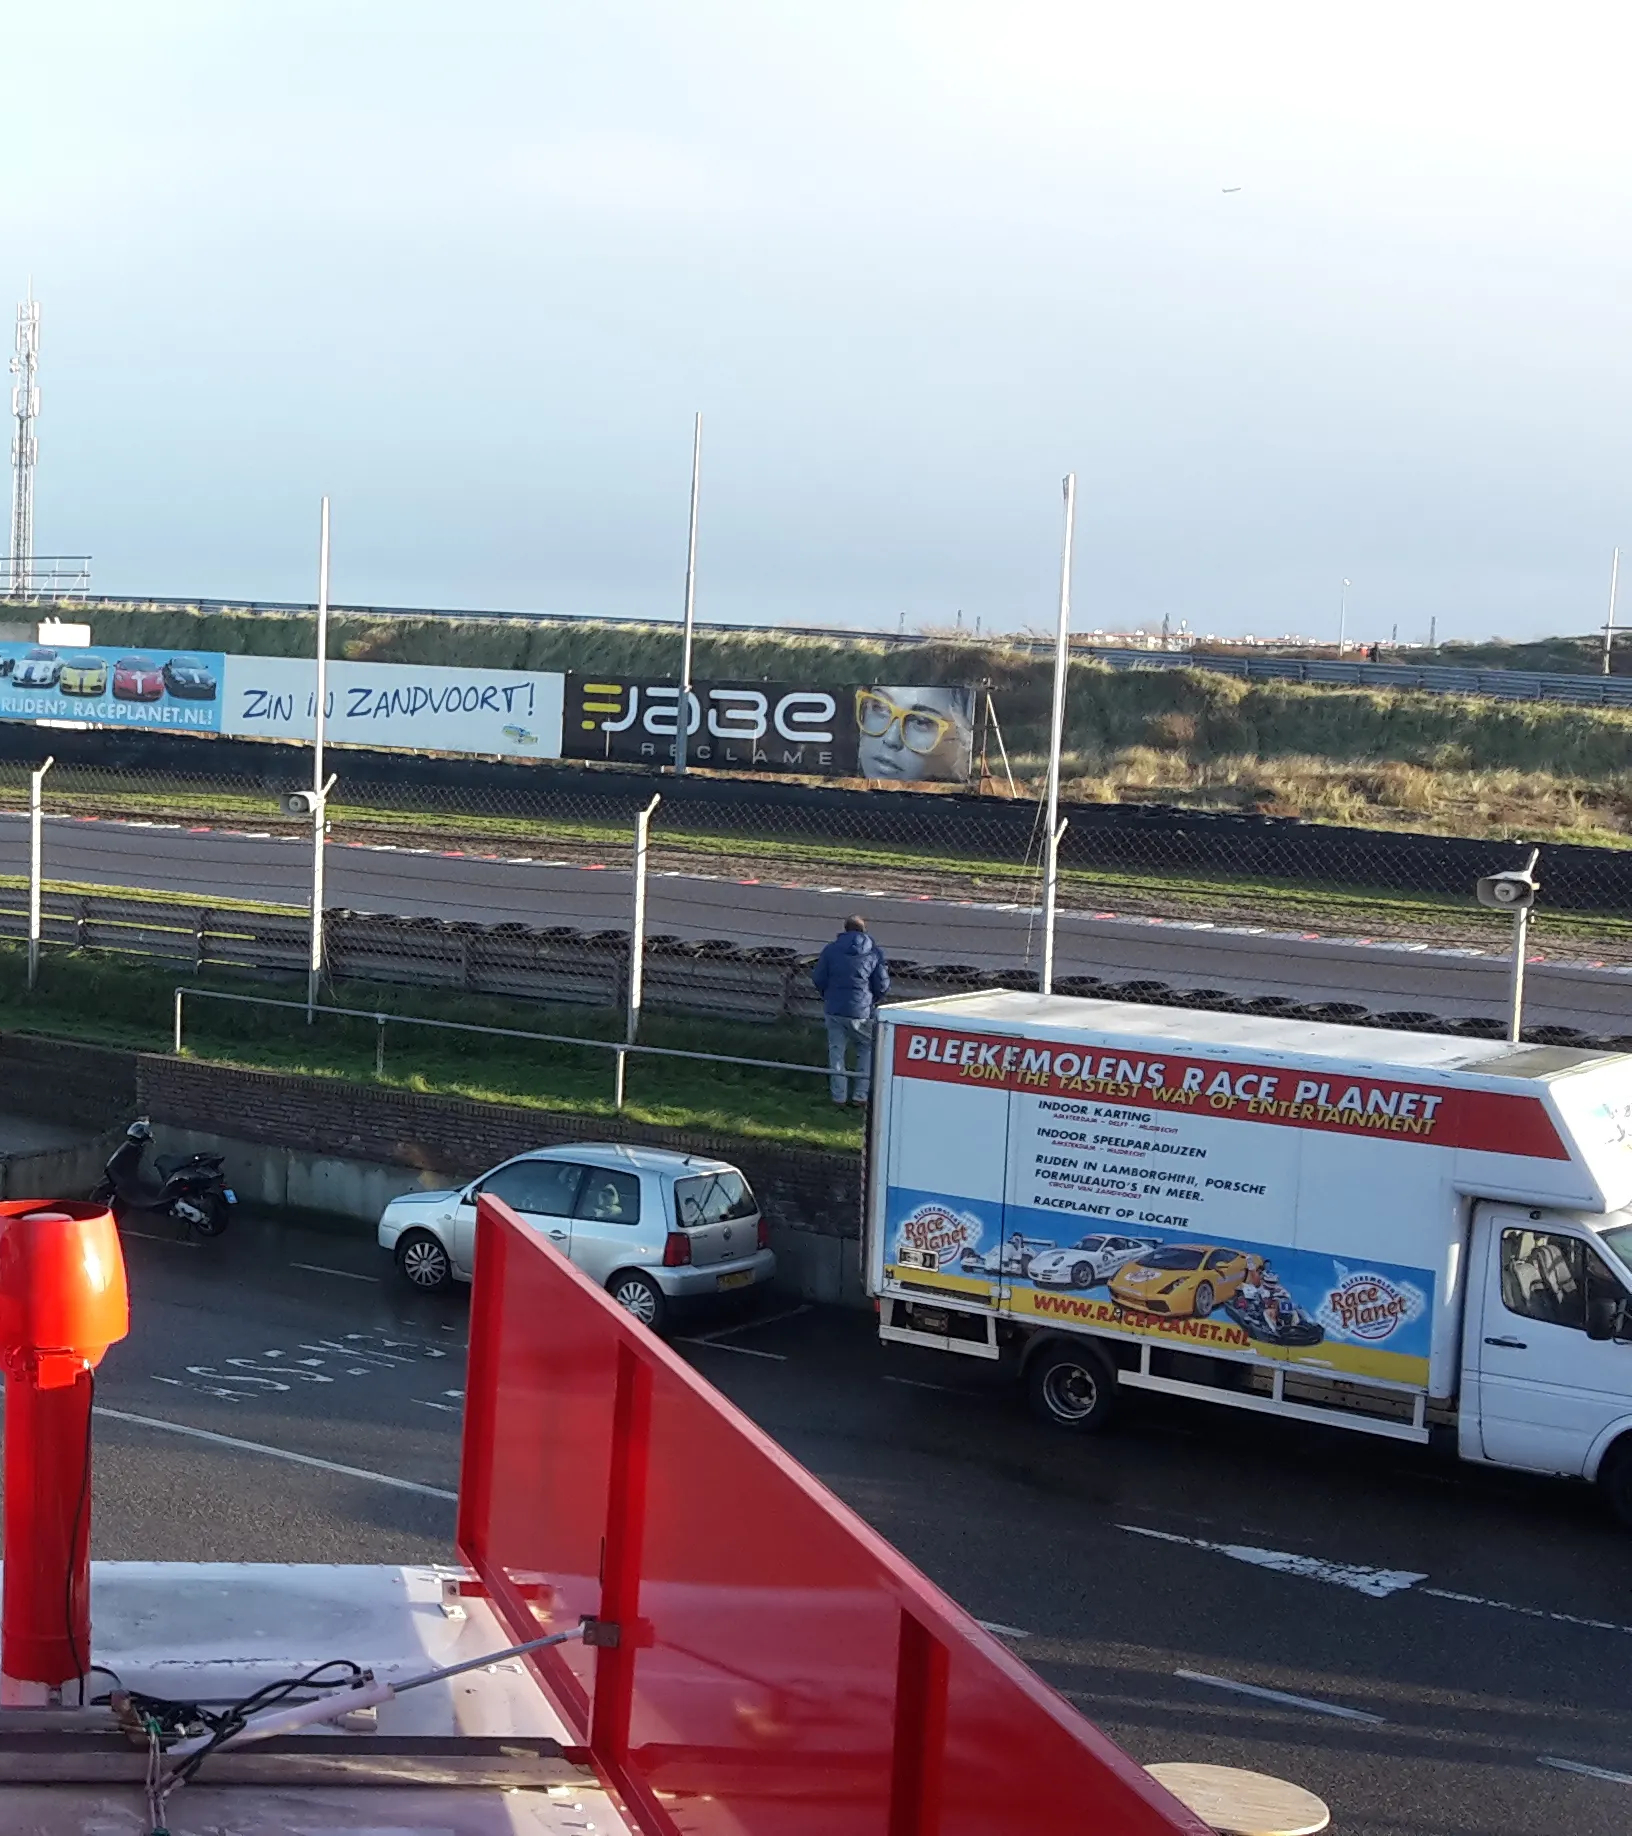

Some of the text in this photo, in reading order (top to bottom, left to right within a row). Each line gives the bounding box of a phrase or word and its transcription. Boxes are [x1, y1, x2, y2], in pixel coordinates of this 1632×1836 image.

[1, 698, 67, 716] RIJDEN?
[73, 702, 213, 726] RACEPLANET.NL!
[243, 690, 292, 721] ZIN
[346, 682, 535, 719] ZANDVOORT!
[641, 742, 833, 765] RECLAME
[907, 1034, 1443, 1120] BLEEKEMOLENS RACE PLANET
[959, 1062, 1436, 1136] JOIN THE FASTEST WAY OF ENTERTAINMENT
[1038, 1100, 1151, 1123] INDOOR KARTING
[1037, 1127, 1207, 1158] INDOOR SPEELPARADIJZEN
[1035, 1154, 1078, 1169] RIJDEN
[1083, 1161, 1098, 1171] IN
[1205, 1177, 1267, 1195] PORSCHE
[1035, 1168, 1204, 1201] FORMULEAUTO'S EN MEER.
[1033, 1195, 1189, 1227] RACEPLANET OP LOCATIE
[905, 1217, 945, 1240] Race
[1330, 1287, 1378, 1312] Race
[1341, 1296, 1407, 1329] Planet
[1033, 1294, 1251, 1347] WWW.RACEPLANET.NL
